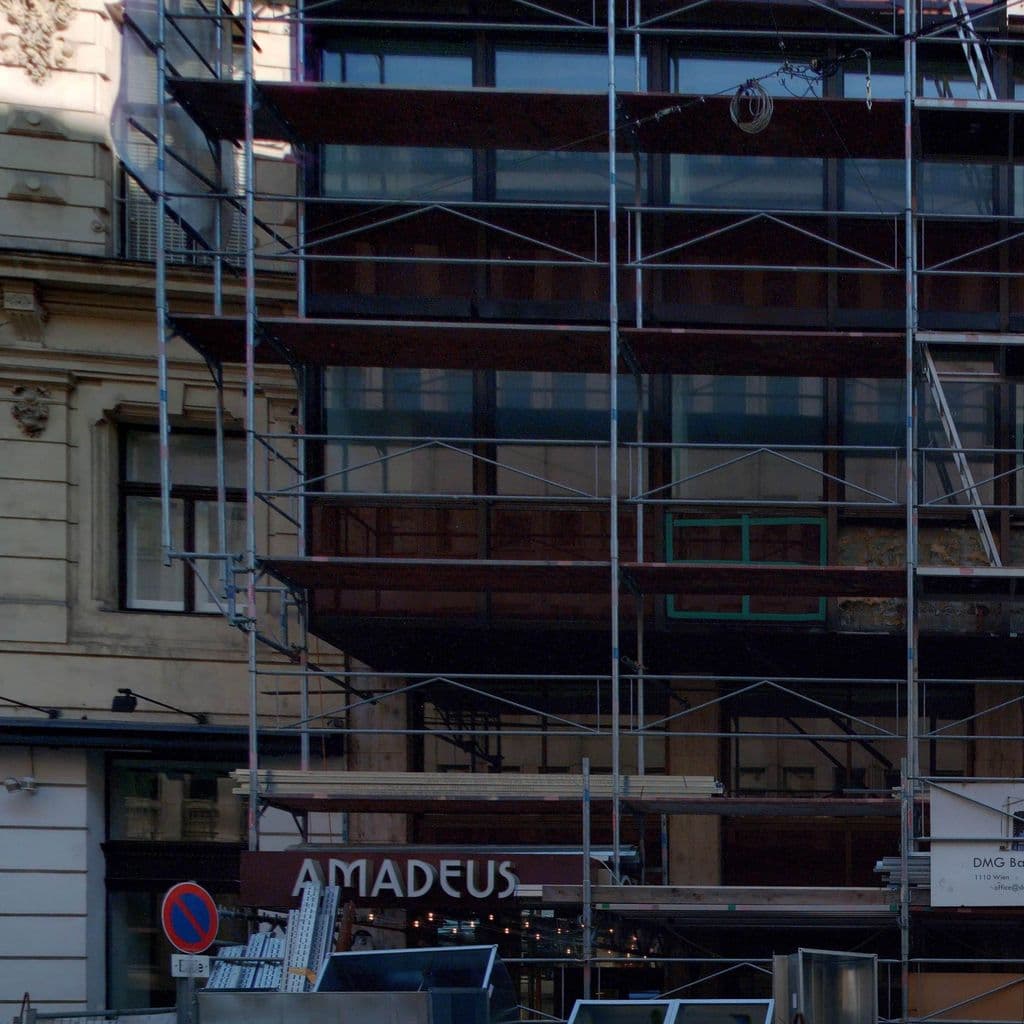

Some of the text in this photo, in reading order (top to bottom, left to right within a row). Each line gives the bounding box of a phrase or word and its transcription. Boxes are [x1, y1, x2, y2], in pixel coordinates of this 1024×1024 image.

[973, 857, 1005, 867] DMG
[291, 858, 519, 899] AMADEUS
[993, 873, 1010, 881] Wien
